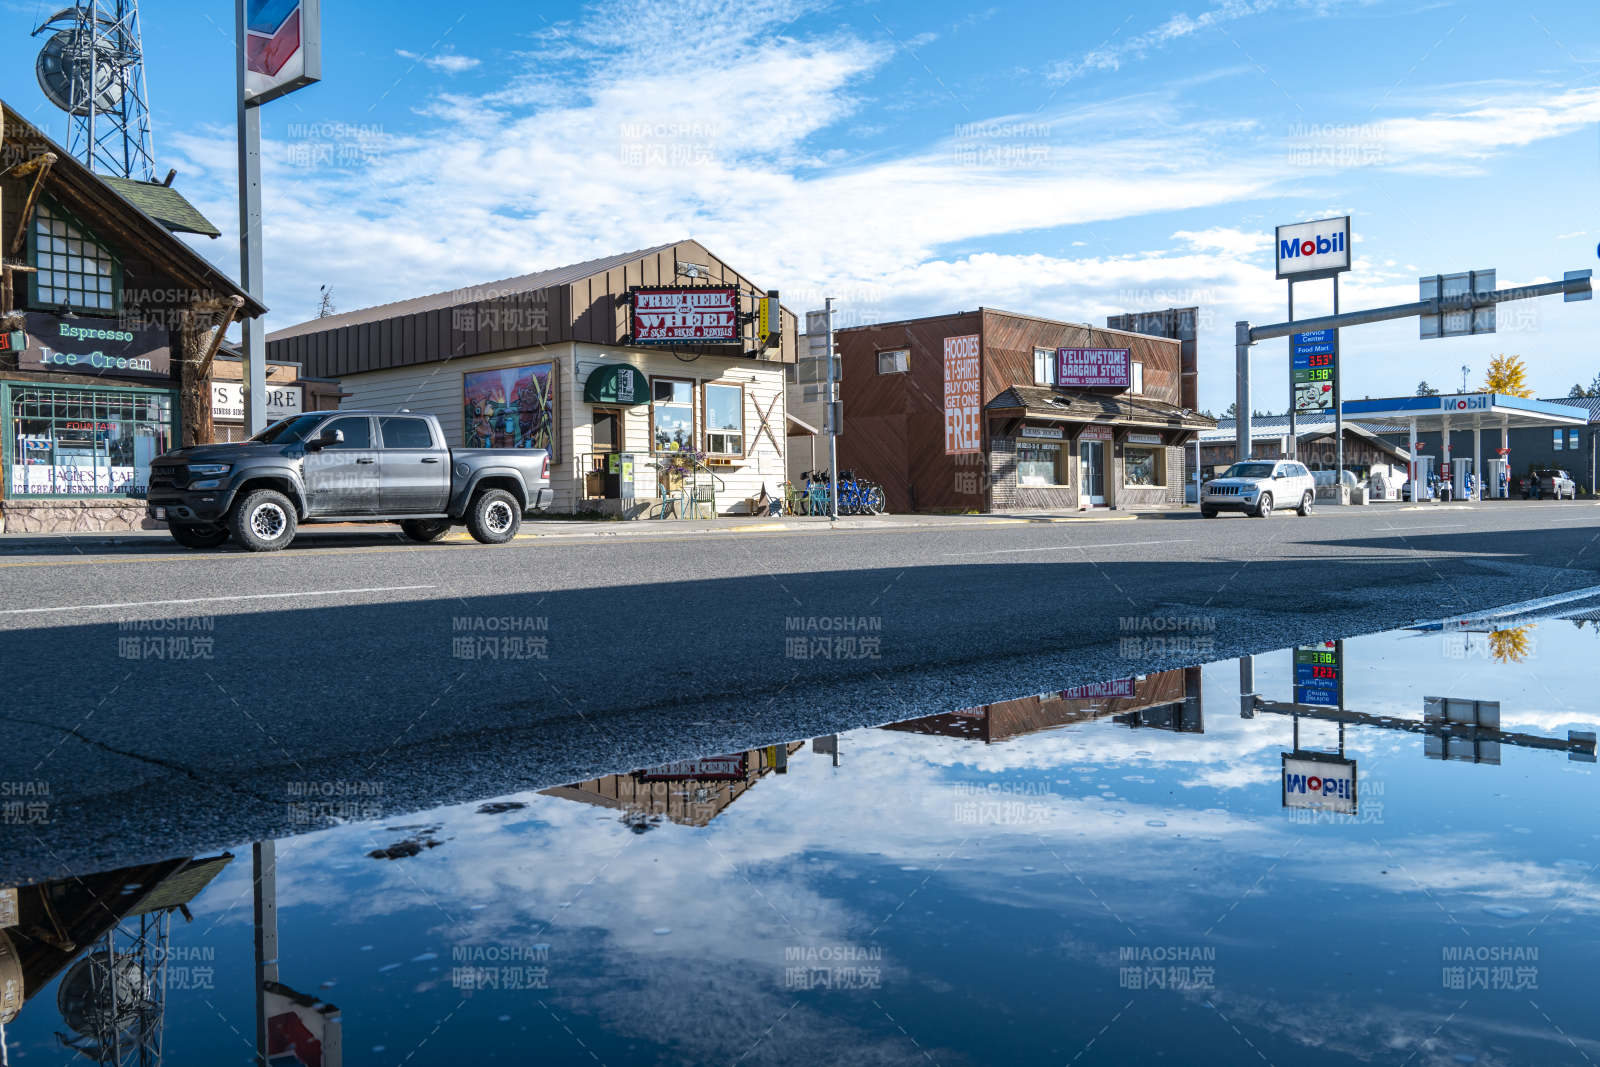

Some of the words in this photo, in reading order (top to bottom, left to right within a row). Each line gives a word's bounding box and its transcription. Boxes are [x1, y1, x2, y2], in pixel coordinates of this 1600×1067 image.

[1280, 231, 1345, 259] Mobil
[639, 313, 735, 328] WHEEL
[59, 323, 134, 342] Espresso
[945, 336, 979, 359] HOODIES
[39, 346, 78, 366] Ice
[91, 350, 152, 371] Cream
[1062, 350, 1126, 364] YELLOWSTONE
[945, 361, 951, 381] &
[951, 358, 979, 380] T-SHIRTS
[1062, 364, 1098, 377] BARGAIN
[1100, 364, 1126, 377] STORE
[945, 381, 962, 394] BUY
[961, 380, 979, 393] ONE
[945, 395, 961, 408] GET
[961, 394, 979, 407] ONE
[1443, 397, 1488, 411] Mobil
[945, 406, 980, 450] FREE
[13, 484, 29, 494] ICE
